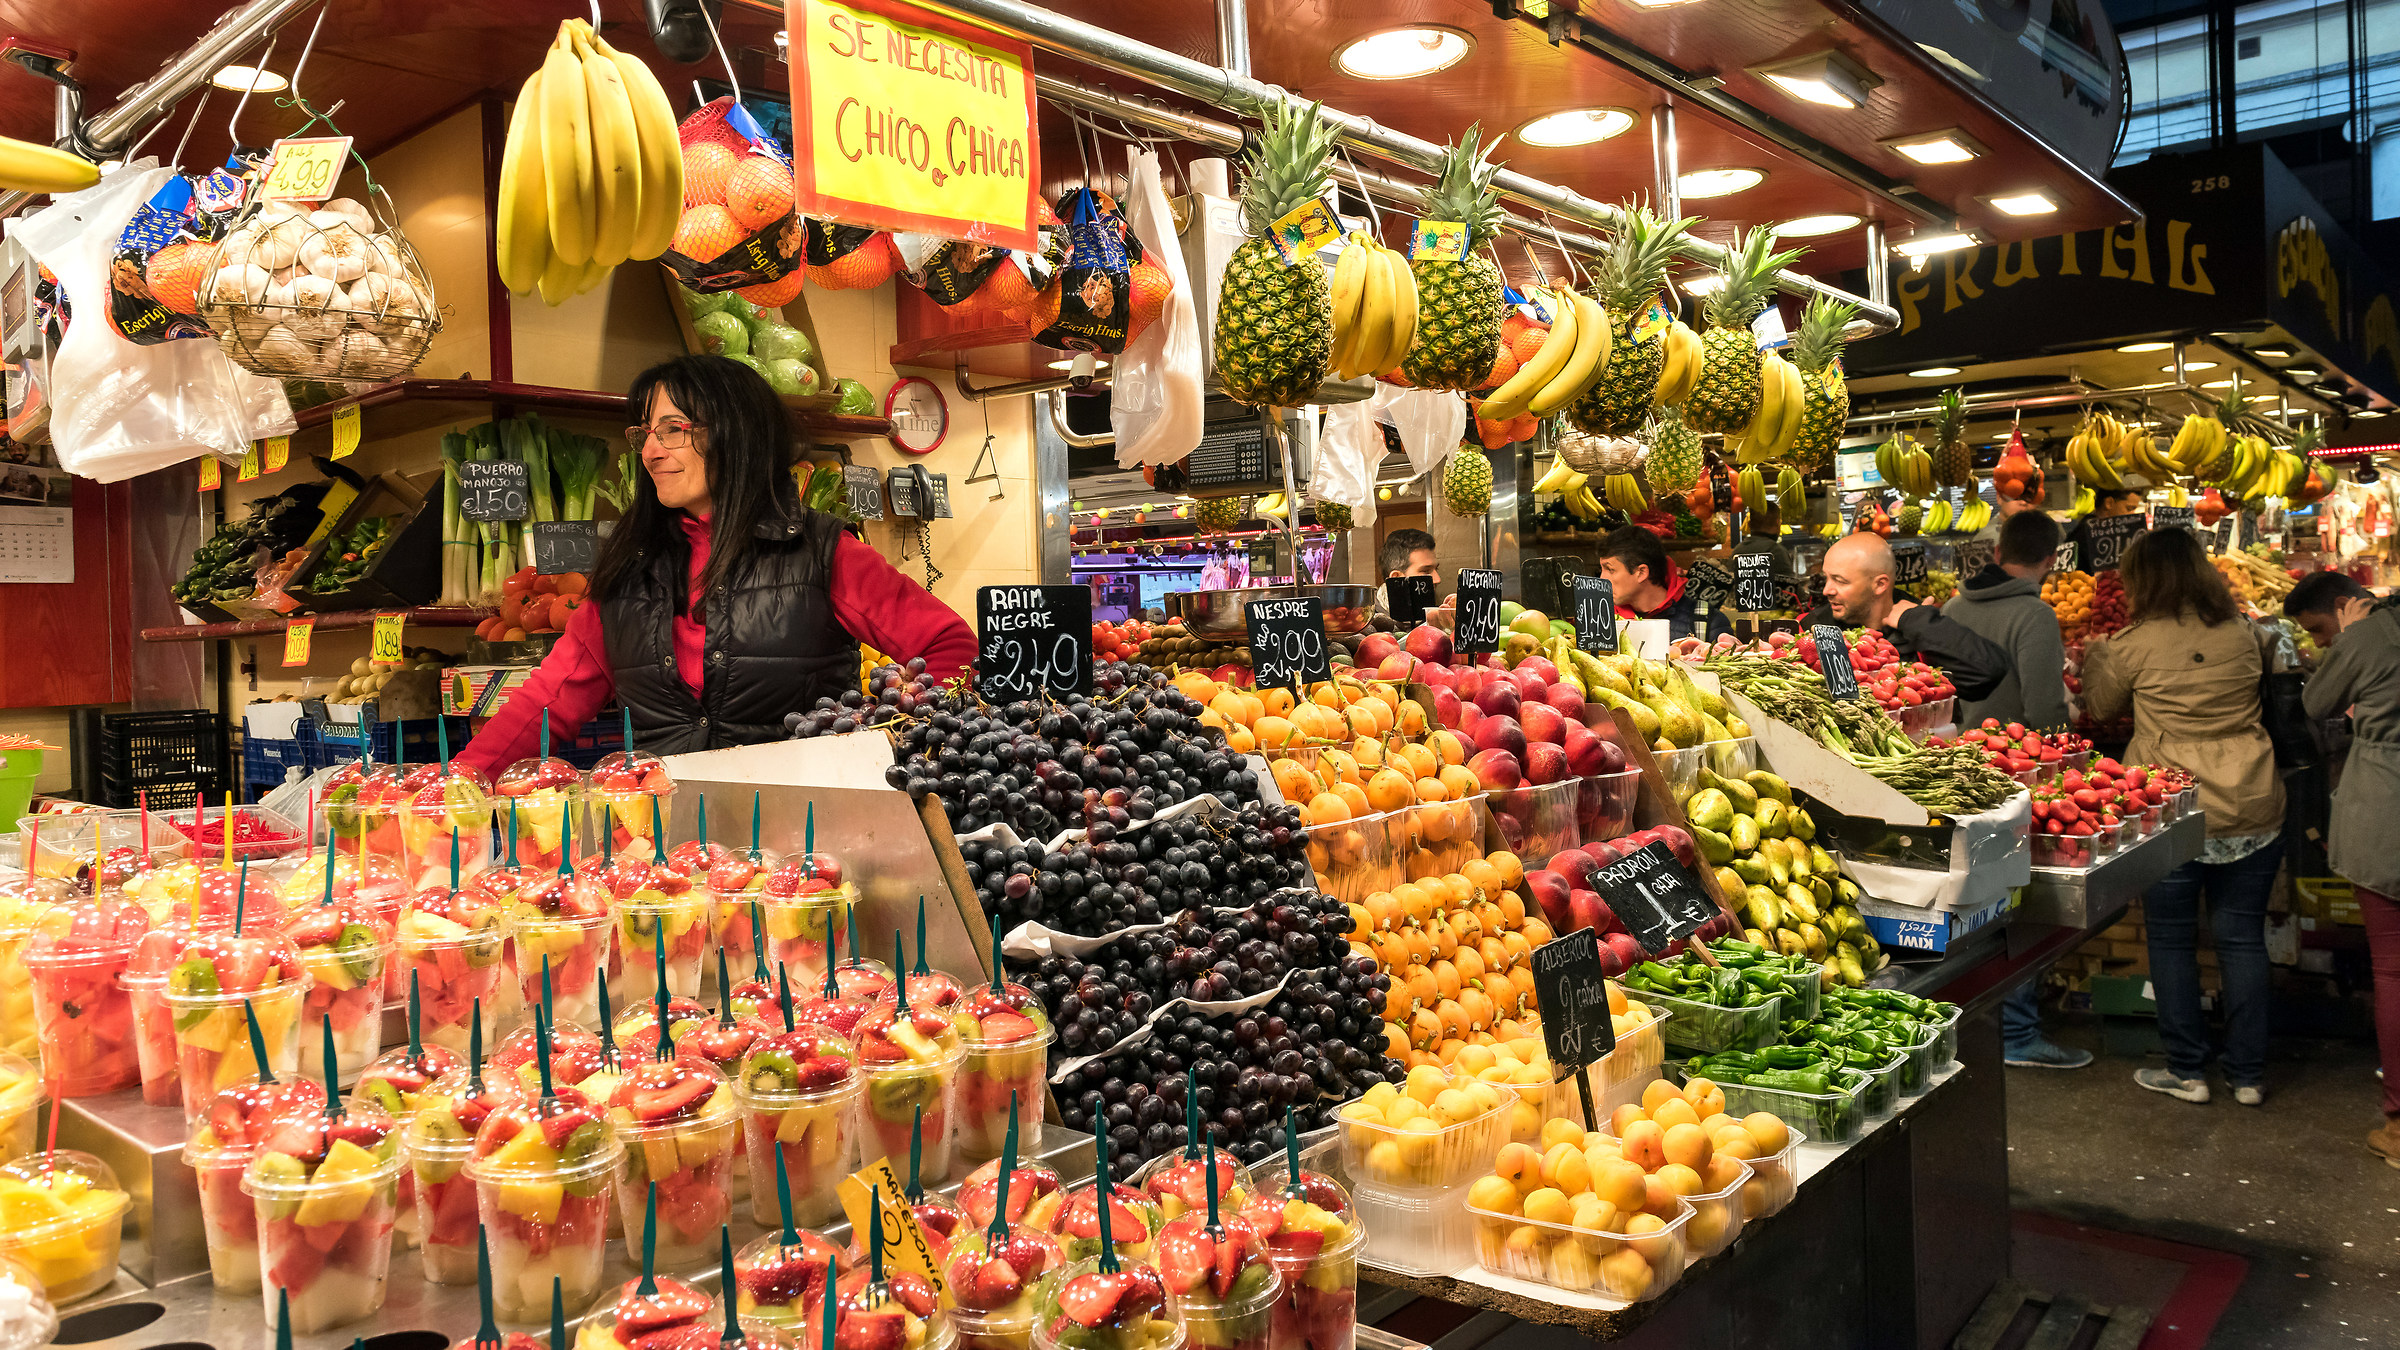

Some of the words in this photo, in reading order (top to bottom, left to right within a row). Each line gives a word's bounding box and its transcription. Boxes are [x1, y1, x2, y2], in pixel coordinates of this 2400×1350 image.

[828, 13, 878, 63] SE
[886, 29, 1008, 99] NECESITA
[835, 96, 930, 172] CHICO
[945, 116, 1025, 179] CHICA
[273, 159, 332, 191] 4,99
[2191, 175, 2231, 194] 258
[120, 304, 167, 335] Escrig
[893, 407, 939, 432] Time
[463, 478, 511, 489] MANOJO
[469, 463, 523, 477] PUERRO
[539, 523, 584, 534] TOMATES
[1740, 579, 1774, 610] 2,49
[986, 610, 1056, 632] NEGRE
[1252, 600, 1310, 620] NESPRE
[1460, 597, 1499, 645] 2,49
[1579, 597, 1613, 641] 1,49
[375, 629, 399, 658] 0,89
[1262, 627, 1325, 682] 2,99
[993, 632, 1078, 696] 2,49
[1897, 921, 1937, 937] Fresh
[1898, 934, 1934, 950] KIWI
[1540, 933, 1593, 973] ALBERCOC
[1591, 1024, 1607, 1053] €
[879, 1166, 943, 1293] MACEDONIA
